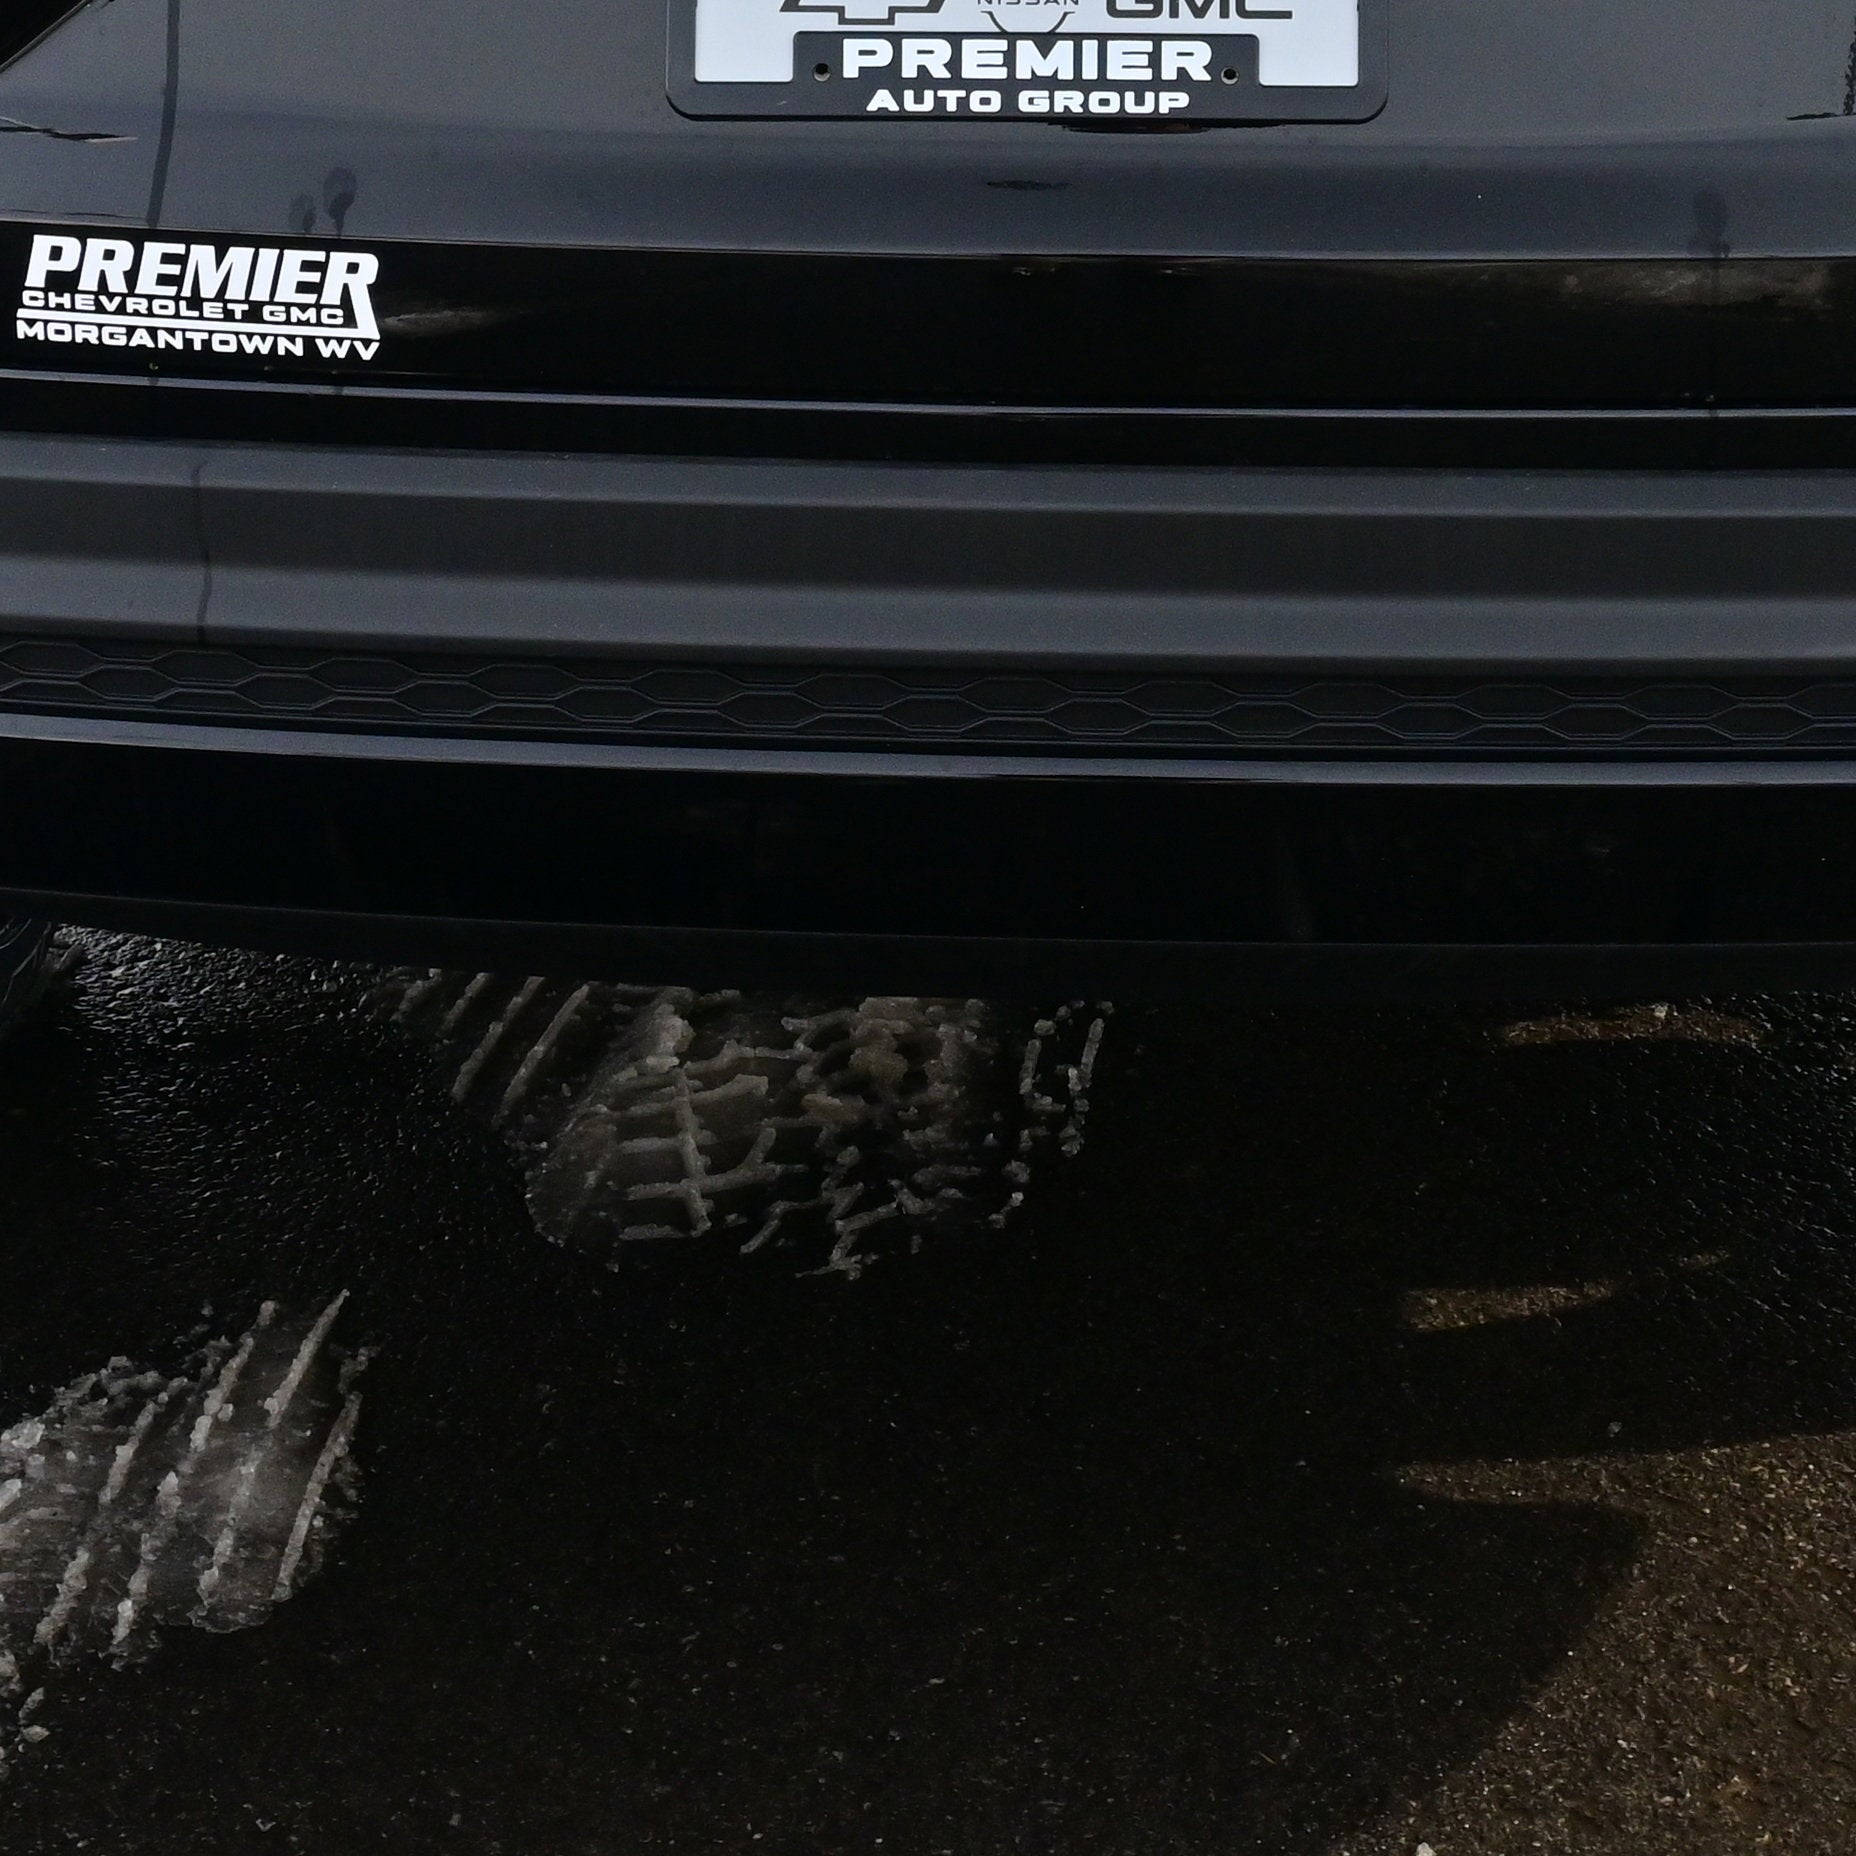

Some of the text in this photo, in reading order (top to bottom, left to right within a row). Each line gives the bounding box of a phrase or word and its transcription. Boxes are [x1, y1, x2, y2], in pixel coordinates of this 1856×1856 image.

[842, 38, 1213, 82] PREMIER
[866, 89, 1190, 114] AUTO GROUP
[22, 290, 345, 325] CHEVROLET GMC
[24, 234, 381, 340] PREMIER
[16, 319, 380, 361] MORGANTOWN WV
